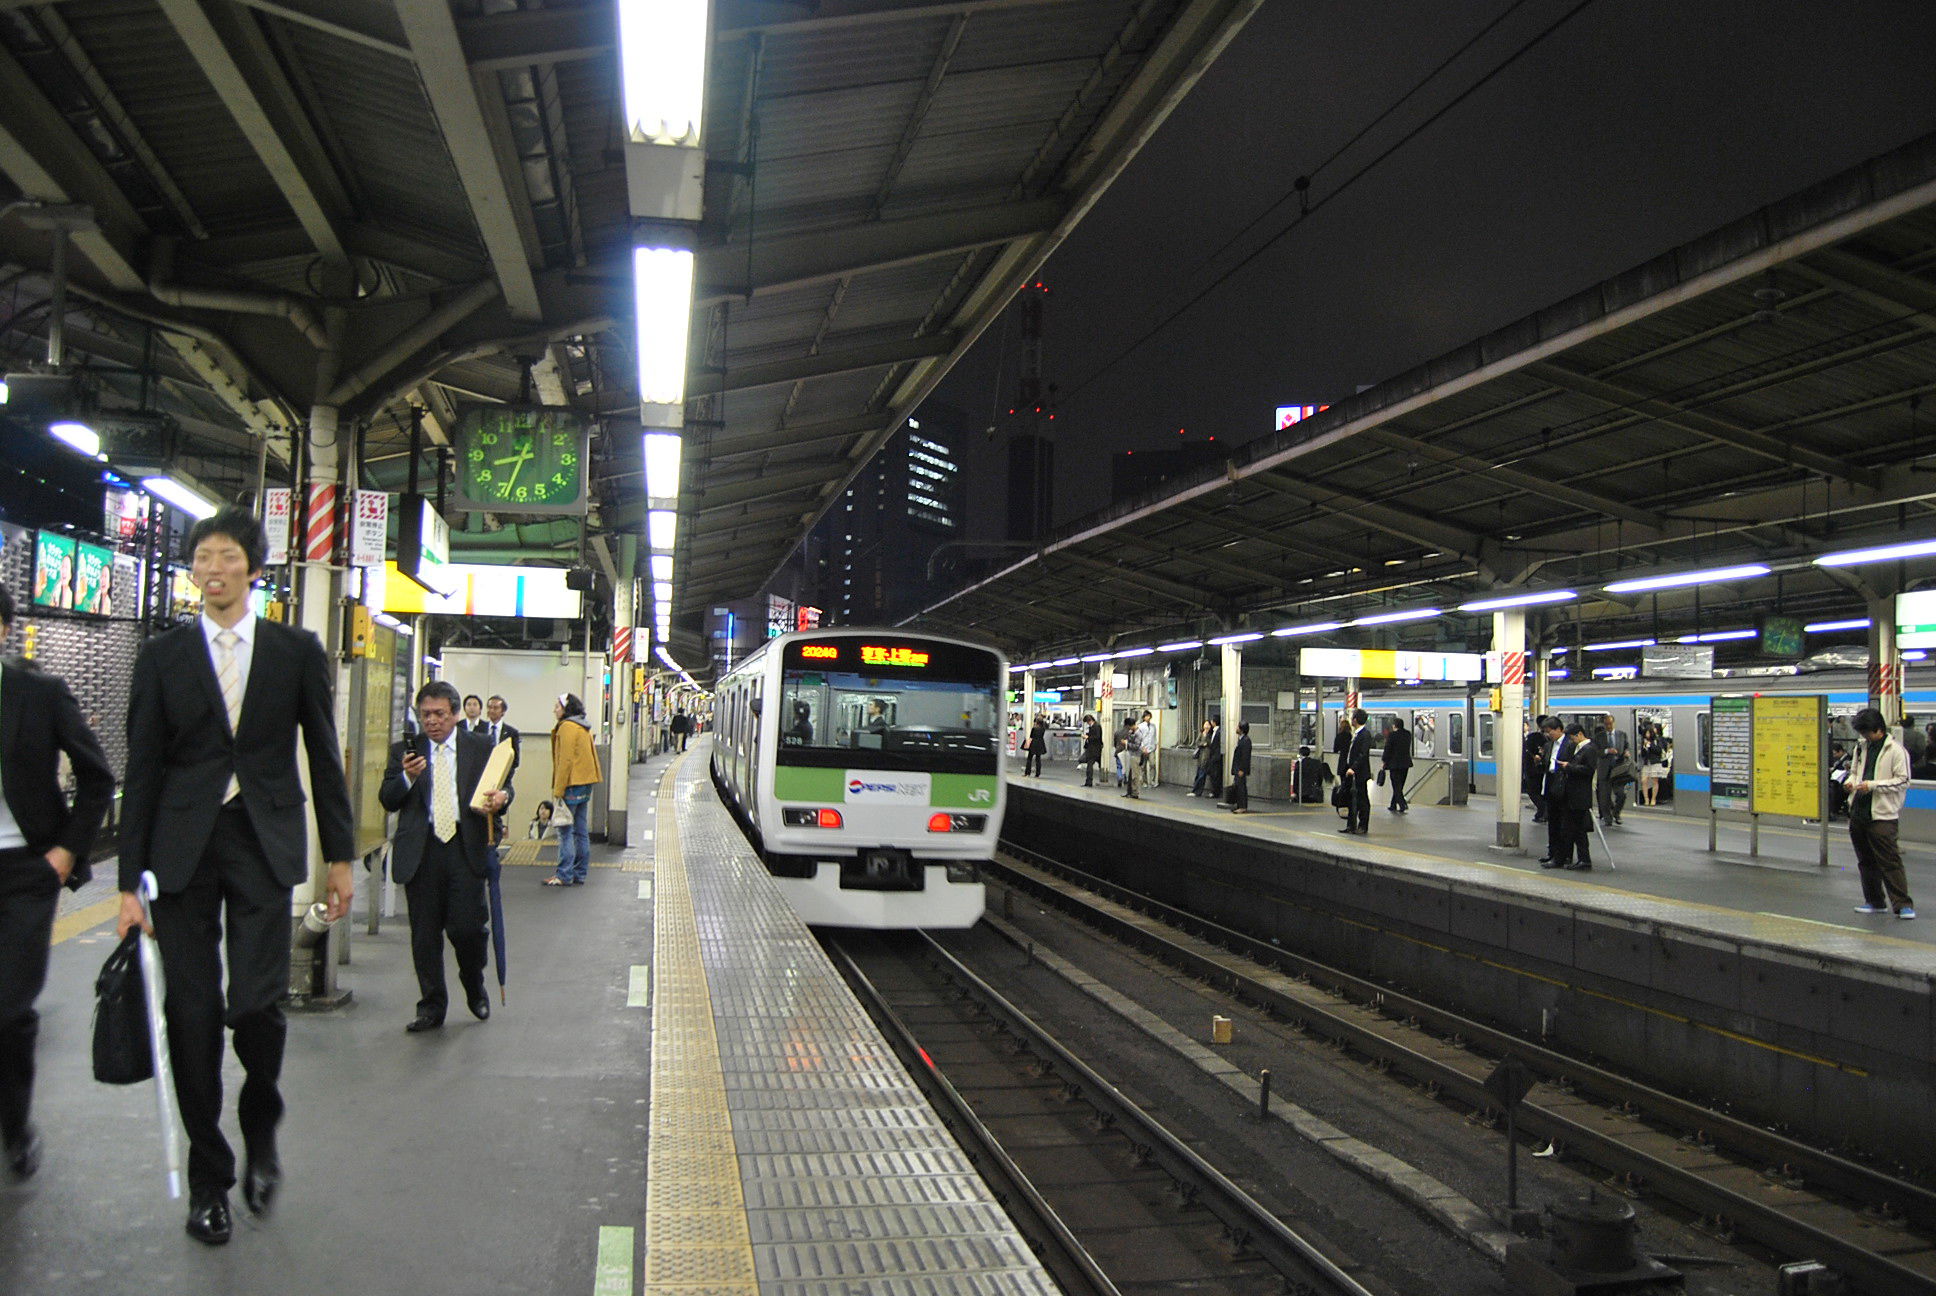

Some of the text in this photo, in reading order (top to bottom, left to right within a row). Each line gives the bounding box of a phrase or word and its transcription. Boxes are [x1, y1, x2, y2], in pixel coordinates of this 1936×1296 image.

[499, 416, 512, 434] 11
[482, 432, 498, 446] 10
[554, 434, 565, 446] 2
[472, 449, 485, 462] 9
[561, 453, 572, 466] 3
[480, 469, 492, 482] 8
[552, 472, 563, 485] 4
[498, 482, 508, 494] 7
[516, 486, 527, 499] 6
[534, 483, 546, 495] 5
[967, 788, 990, 803] JR
